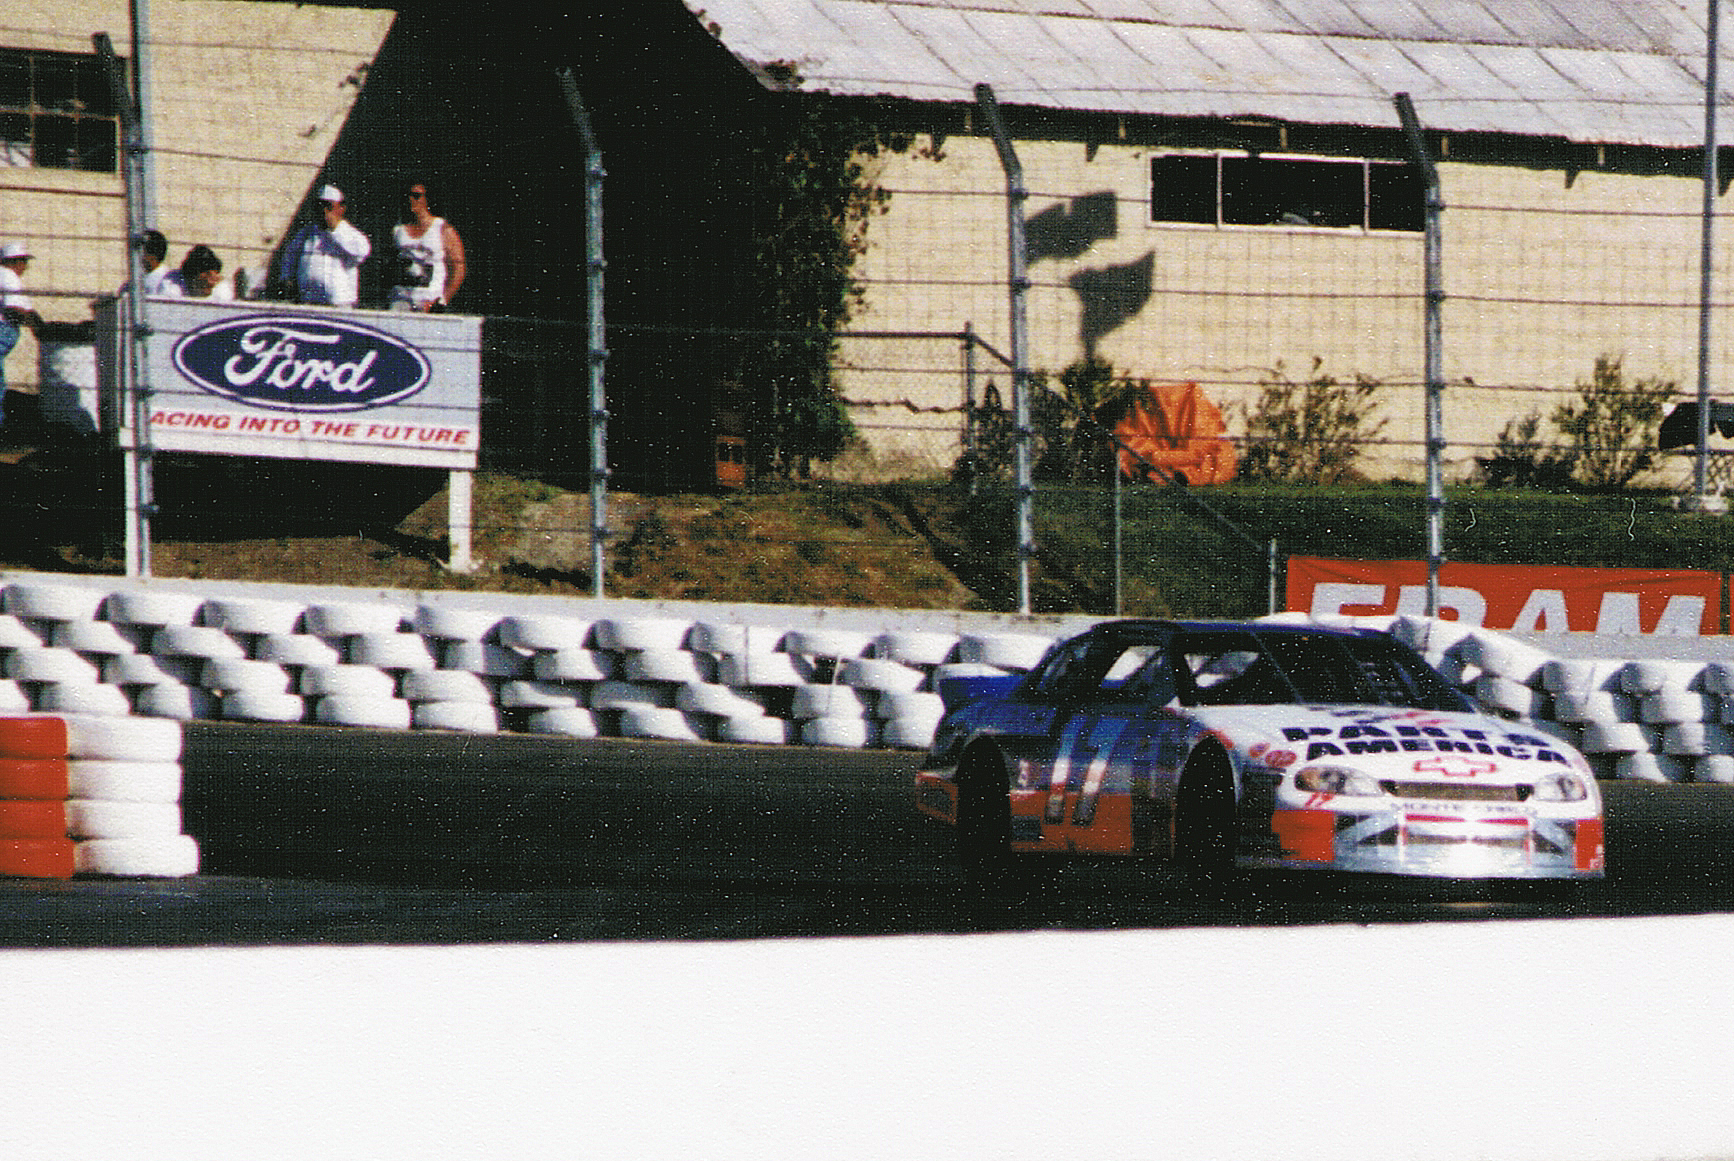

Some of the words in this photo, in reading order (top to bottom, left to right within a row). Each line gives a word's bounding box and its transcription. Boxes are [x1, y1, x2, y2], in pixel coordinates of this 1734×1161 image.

[224, 326, 379, 394] Ford
[149, 410, 231, 430] ACING
[239, 414, 301, 435] INTO
[312, 419, 361, 439] THE
[366, 423, 471, 446] FUTURE
[1281, 725, 1550, 748] PARTS
[1306, 738, 1572, 768] AMERICA
